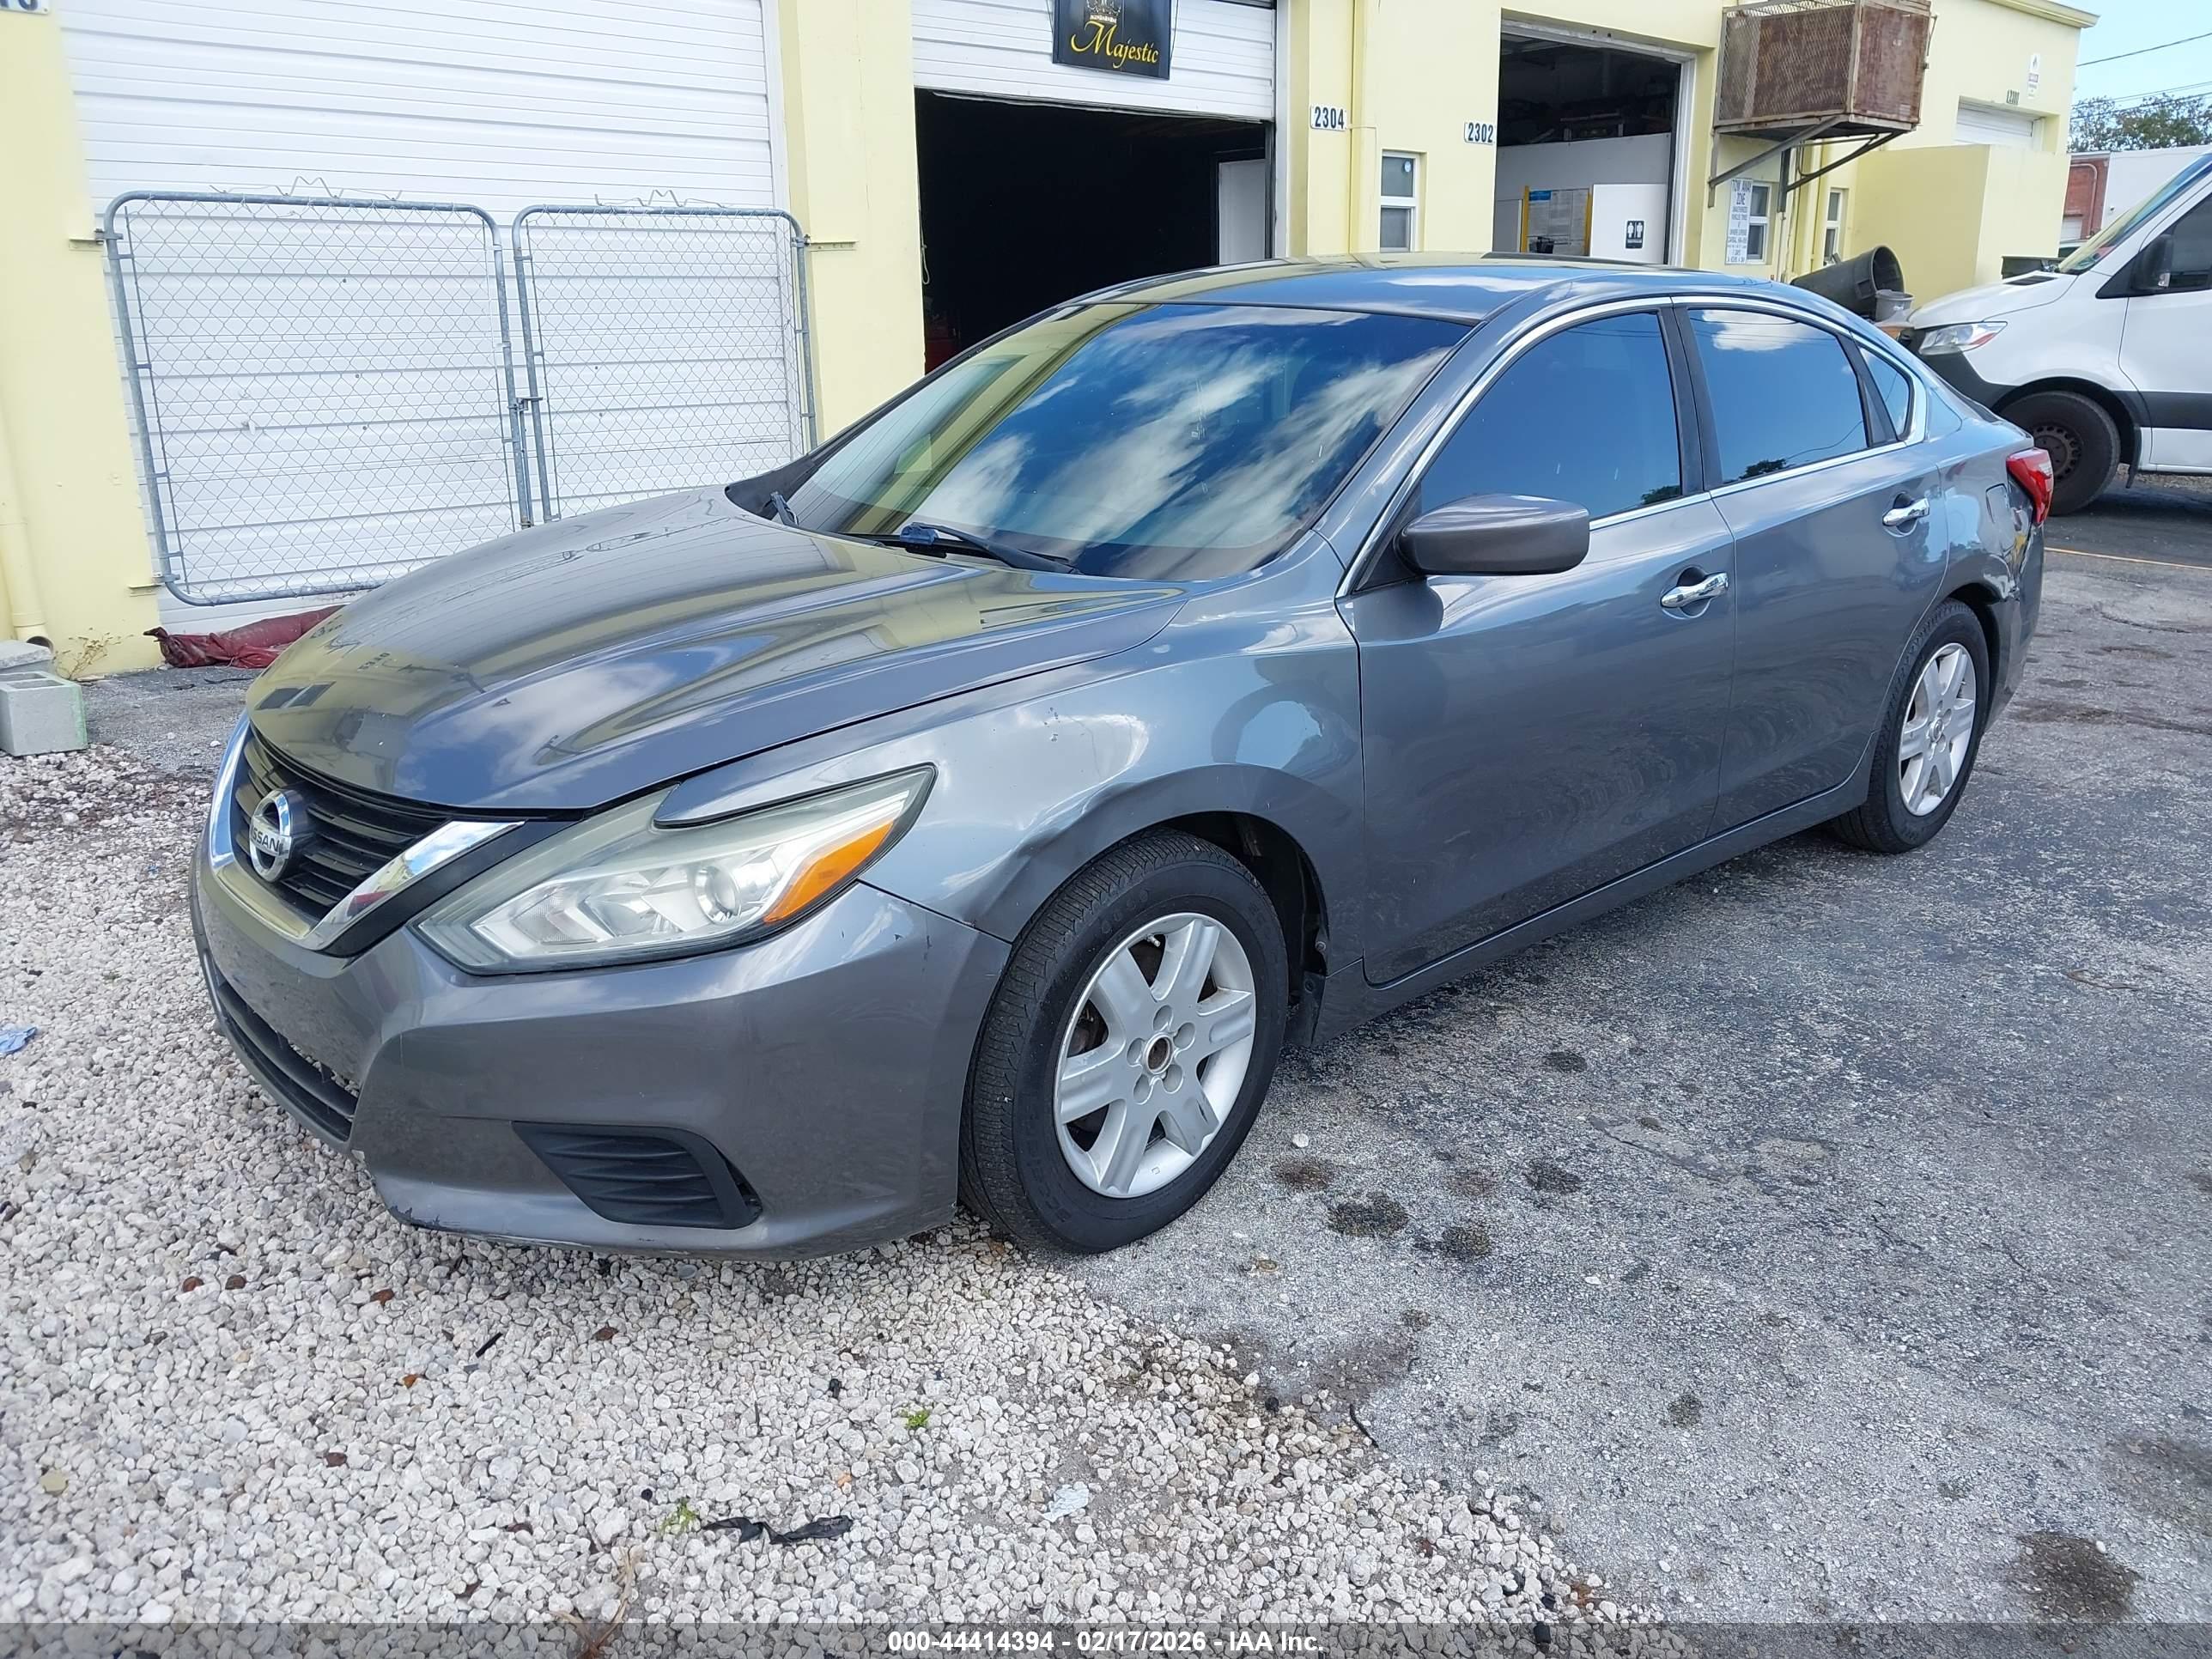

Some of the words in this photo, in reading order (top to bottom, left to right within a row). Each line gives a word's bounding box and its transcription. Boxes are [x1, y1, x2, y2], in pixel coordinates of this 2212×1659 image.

[1071, 21, 1159, 69] Majestic
[1315, 106, 1345, 130] 2304
[1468, 122, 1493, 143] 2302
